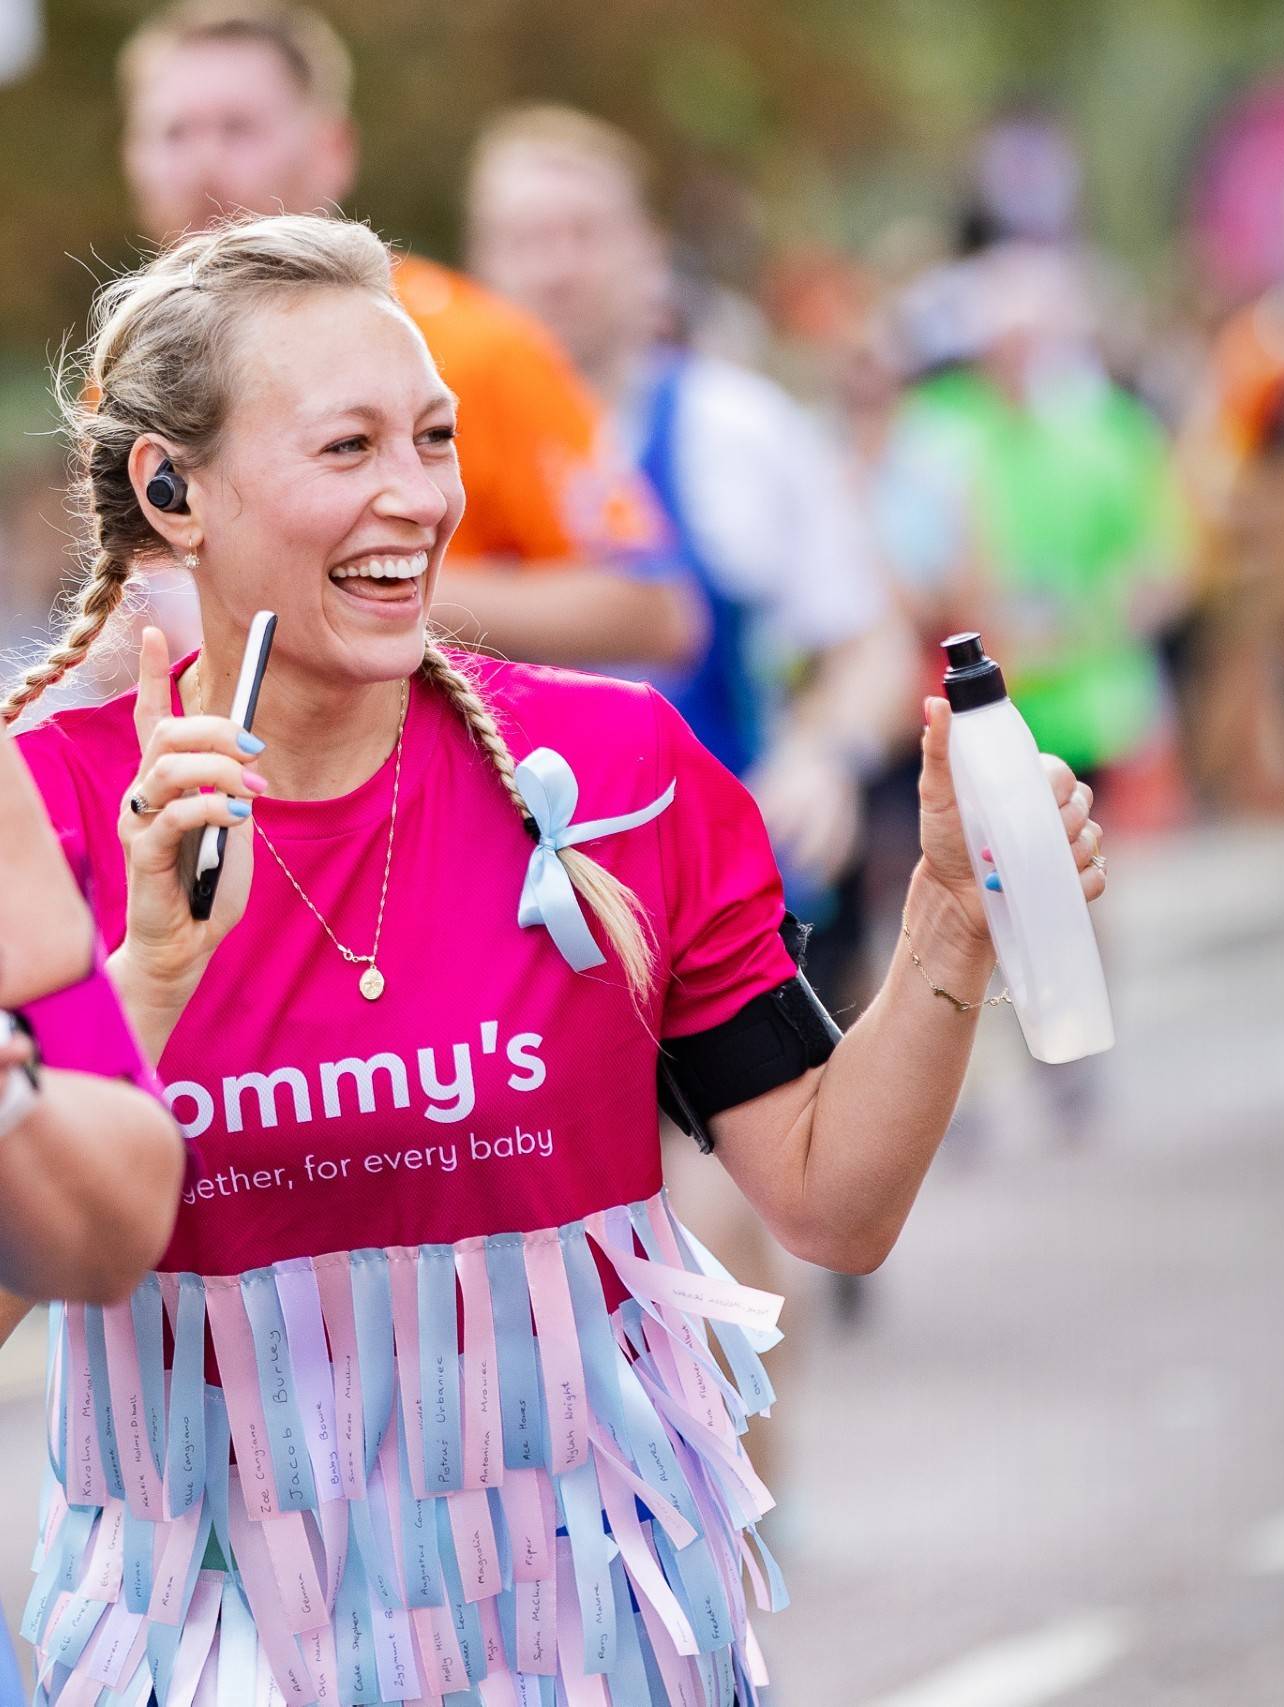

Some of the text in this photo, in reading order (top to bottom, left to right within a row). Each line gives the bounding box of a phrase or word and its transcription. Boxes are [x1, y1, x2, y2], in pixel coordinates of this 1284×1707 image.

[161, 1020, 547, 1139] ommy's
[304, 1155, 351, 1182] for
[364, 1141, 457, 1172] every
[469, 1126, 554, 1161] baby
[270, 1329, 303, 1500] Jacob Burley
[561, 1381, 576, 1419] Wright
[80, 1436, 92, 1496] Karolina
[480, 1432, 490, 1483] Antonina
[473, 1530, 487, 1584] Magnolia
[388, 1634, 405, 1686] Zygmunt
